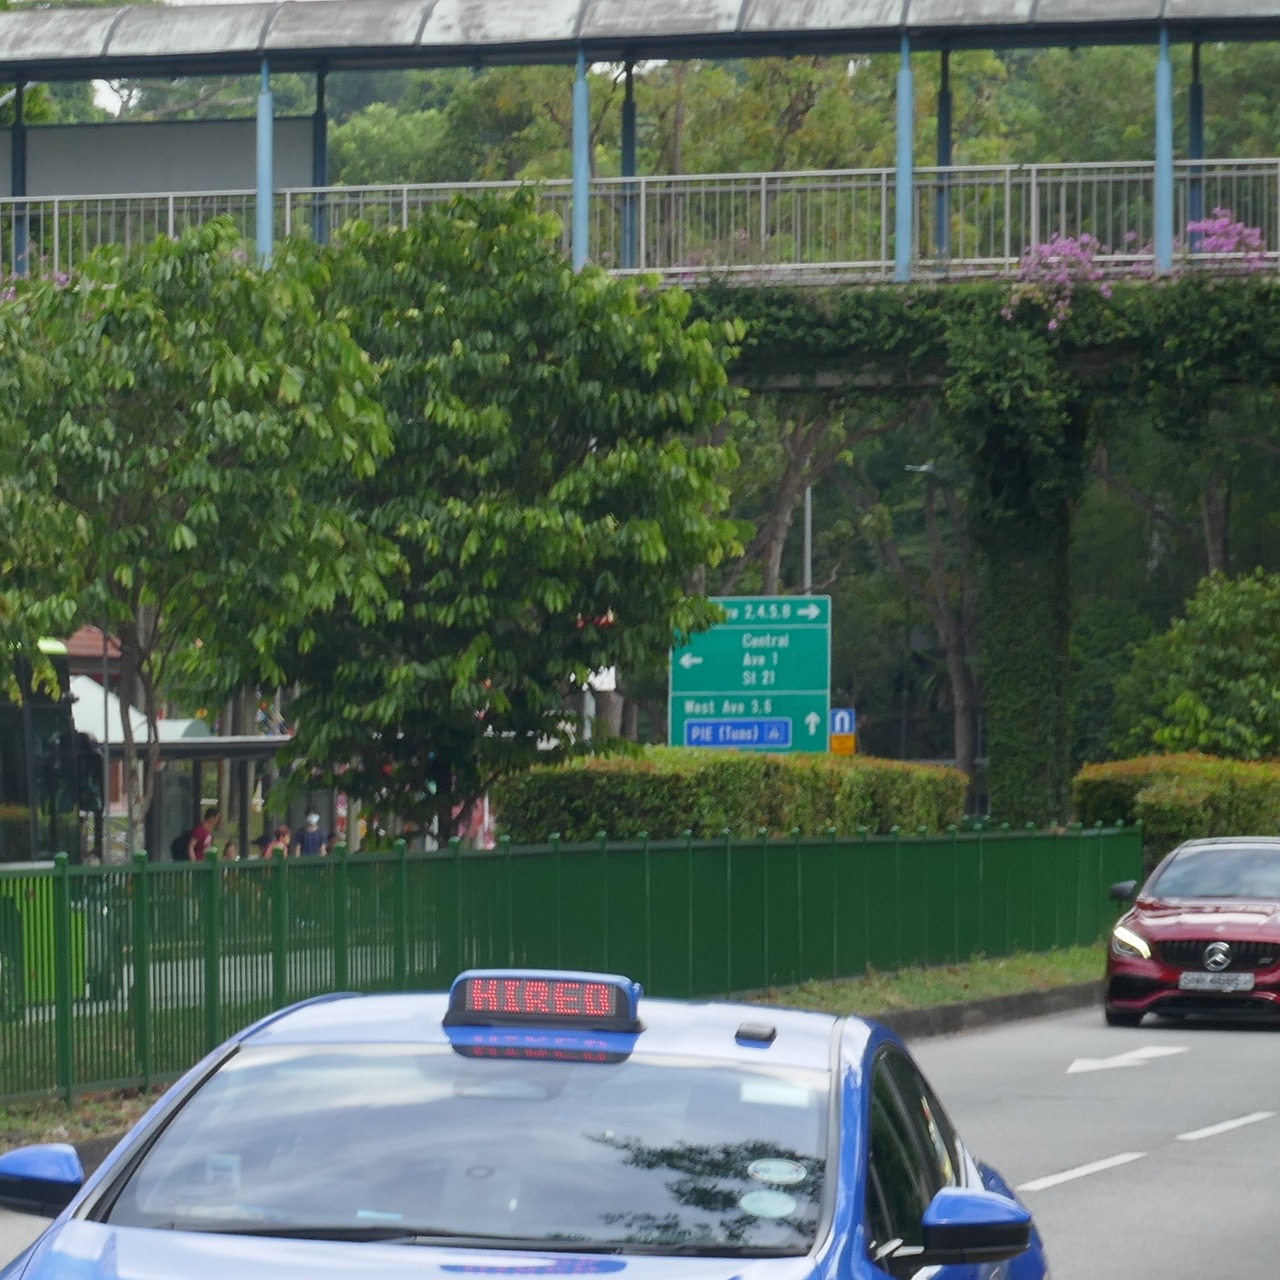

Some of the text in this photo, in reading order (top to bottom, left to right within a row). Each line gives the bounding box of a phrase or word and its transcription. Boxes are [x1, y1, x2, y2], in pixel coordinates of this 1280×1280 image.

[742, 632, 789, 648] Central
[743, 651, 778, 667] Ave 1
[742, 670, 775, 686] St 21
[684, 699, 715, 715] West
[722, 699, 745, 714] Ave
[691, 726, 713, 742] PIE
[472, 979, 610, 1016] HIRED
